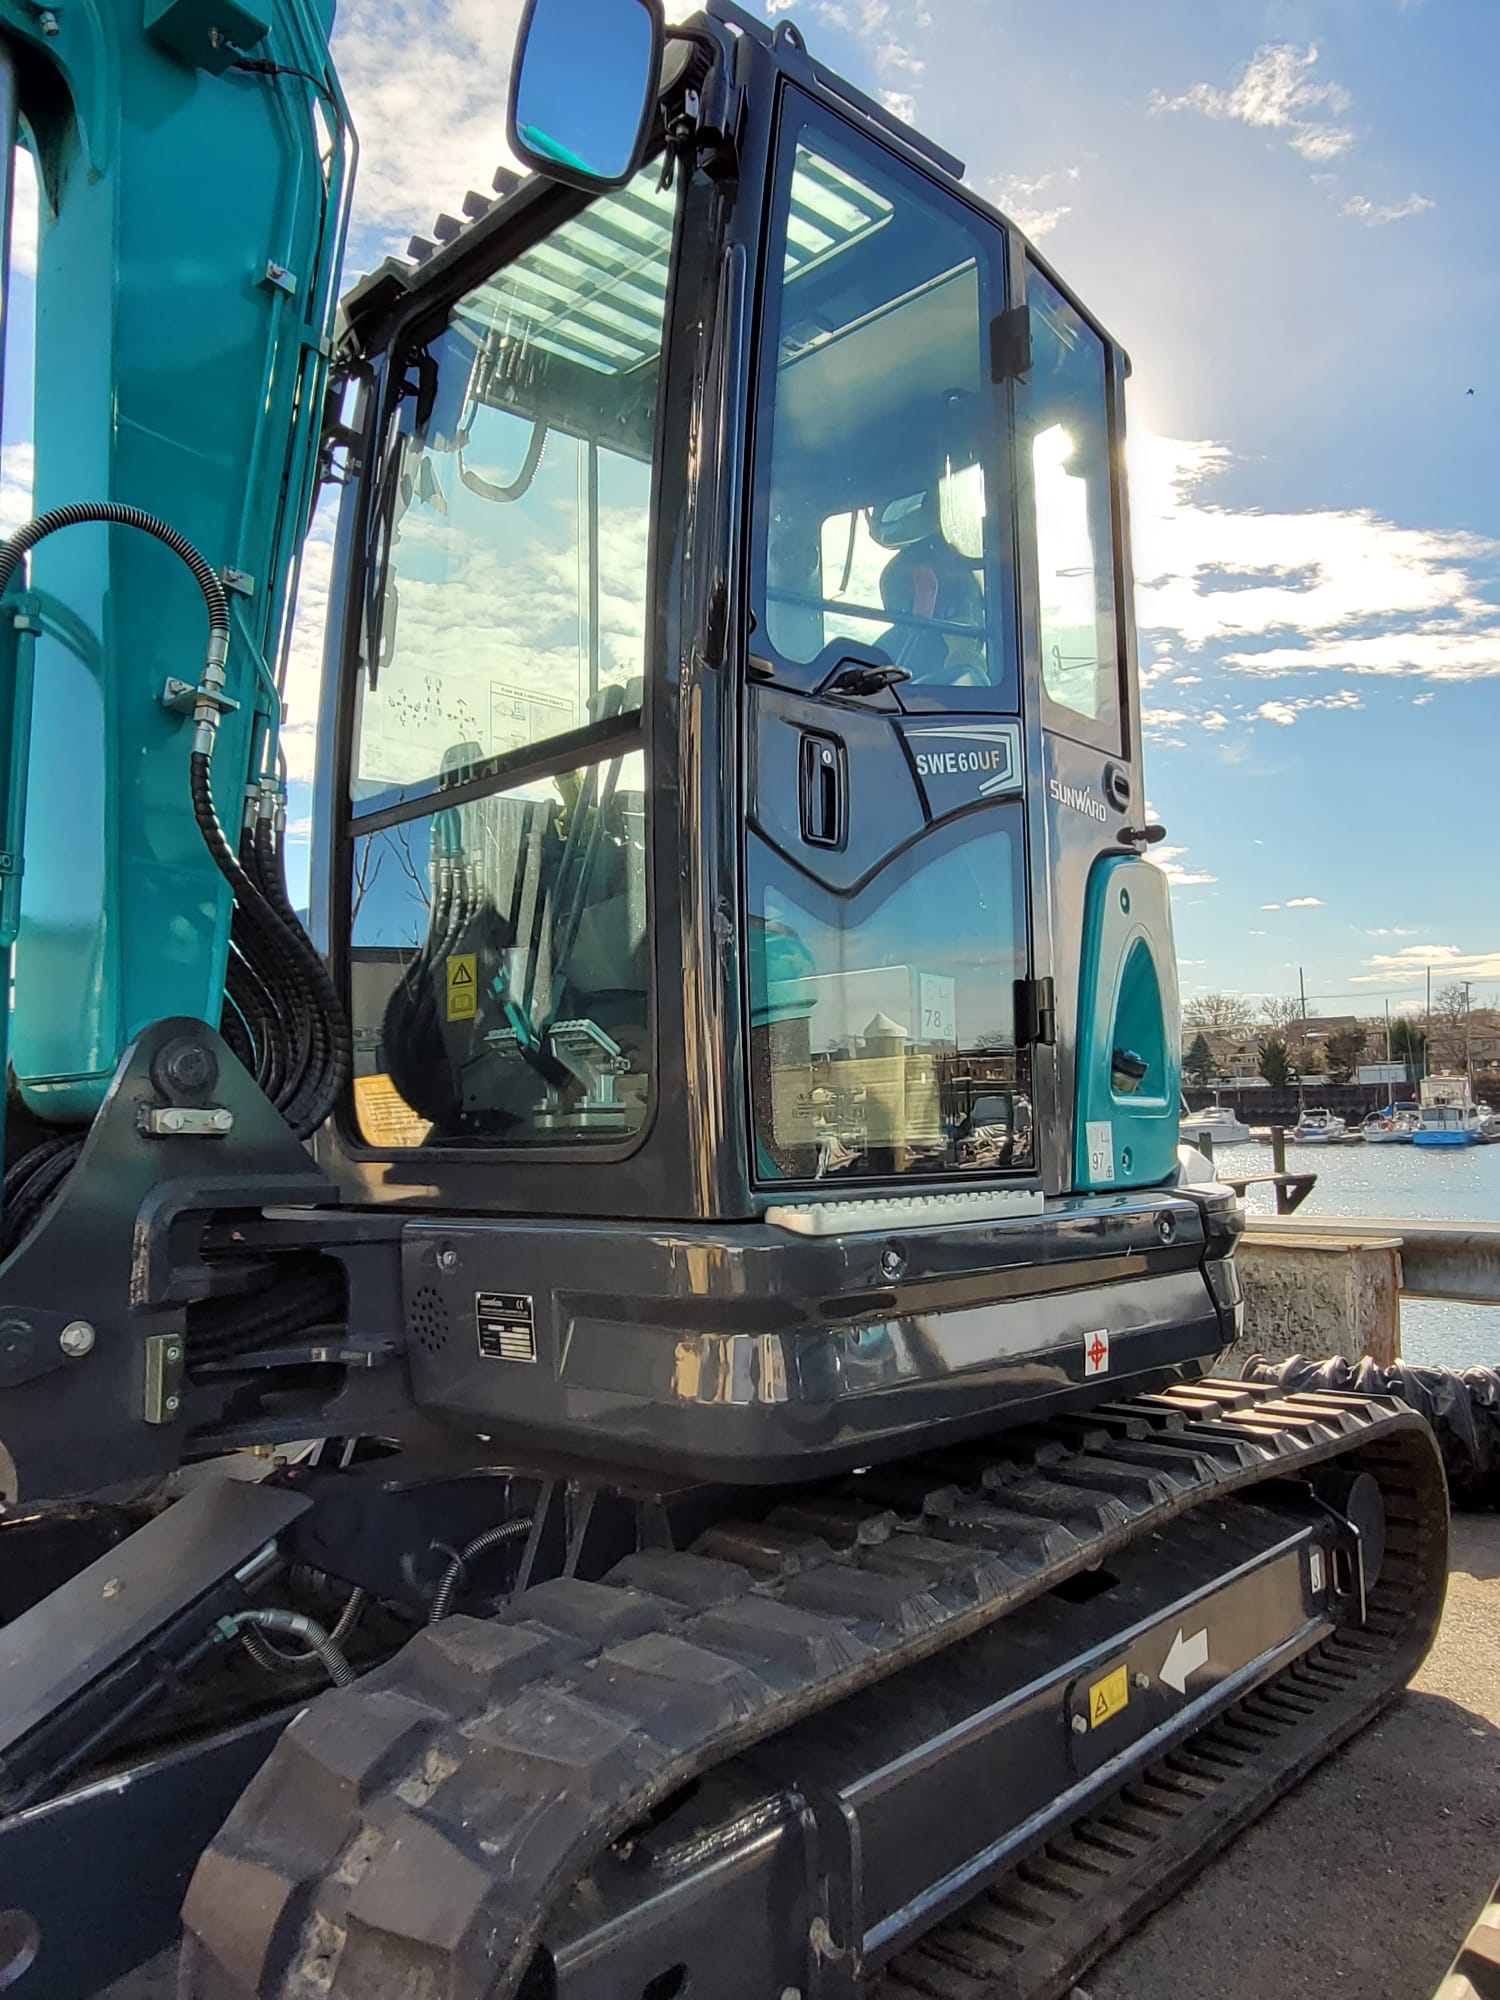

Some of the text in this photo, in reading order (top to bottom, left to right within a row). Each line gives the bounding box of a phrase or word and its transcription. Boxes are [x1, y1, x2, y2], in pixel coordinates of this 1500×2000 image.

[916, 749, 999, 775] SWE60UF
[1050, 779, 1106, 822] SUNWARD
[925, 1009, 941, 1028] 78
[1092, 1152, 1104, 1170] 97
